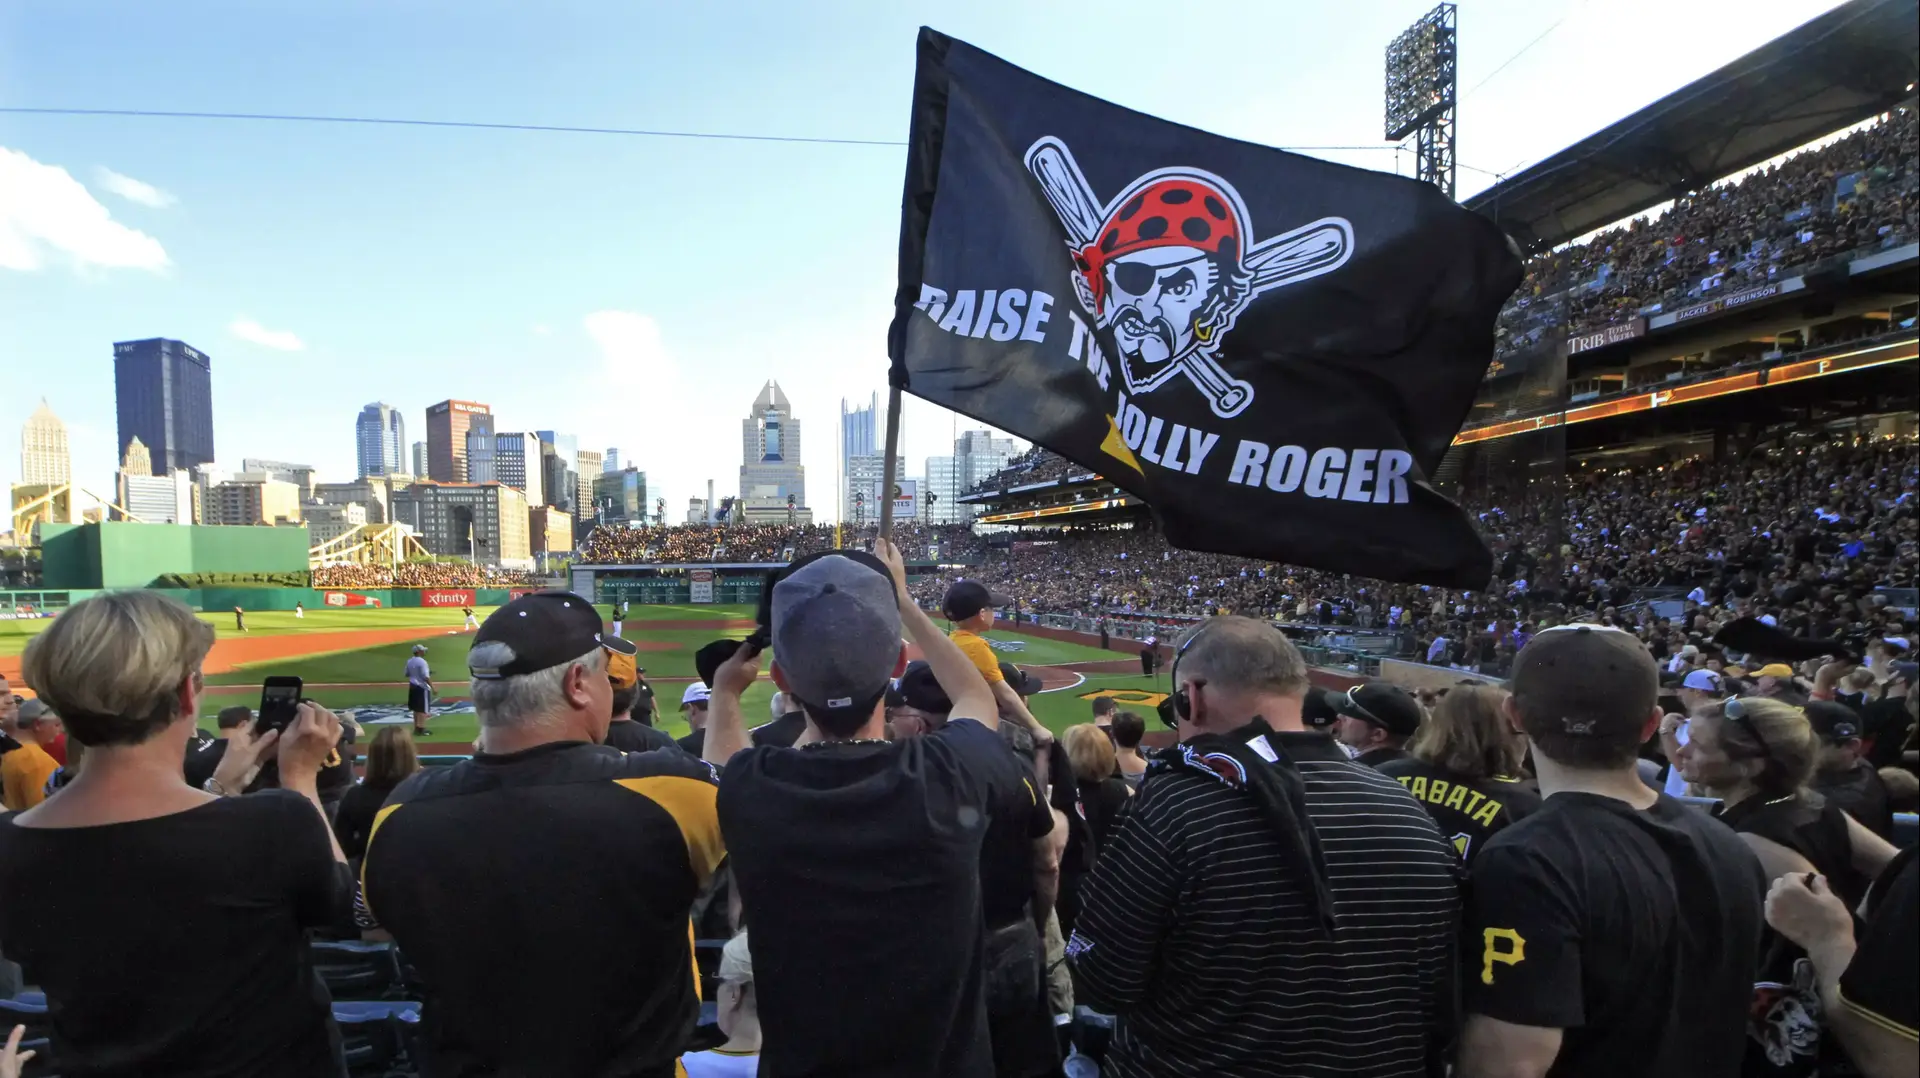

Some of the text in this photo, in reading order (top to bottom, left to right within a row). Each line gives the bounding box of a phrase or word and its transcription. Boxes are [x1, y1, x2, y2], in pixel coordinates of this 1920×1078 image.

[913, 283, 1055, 343] RAISE
[1680, 305, 1709, 319] JACKIE
[1726, 287, 1777, 307] ROBINSON
[1567, 333, 1604, 354] TRIB
[1607, 323, 1634, 335] TOTAL
[1608, 332, 1635, 344] MEDIA
[1112, 390, 1413, 504] JOLLY ROGER
[429, 592, 467, 605] xfinity
[1397, 776, 1502, 827] TABATA
[1481, 927, 1526, 984] P
